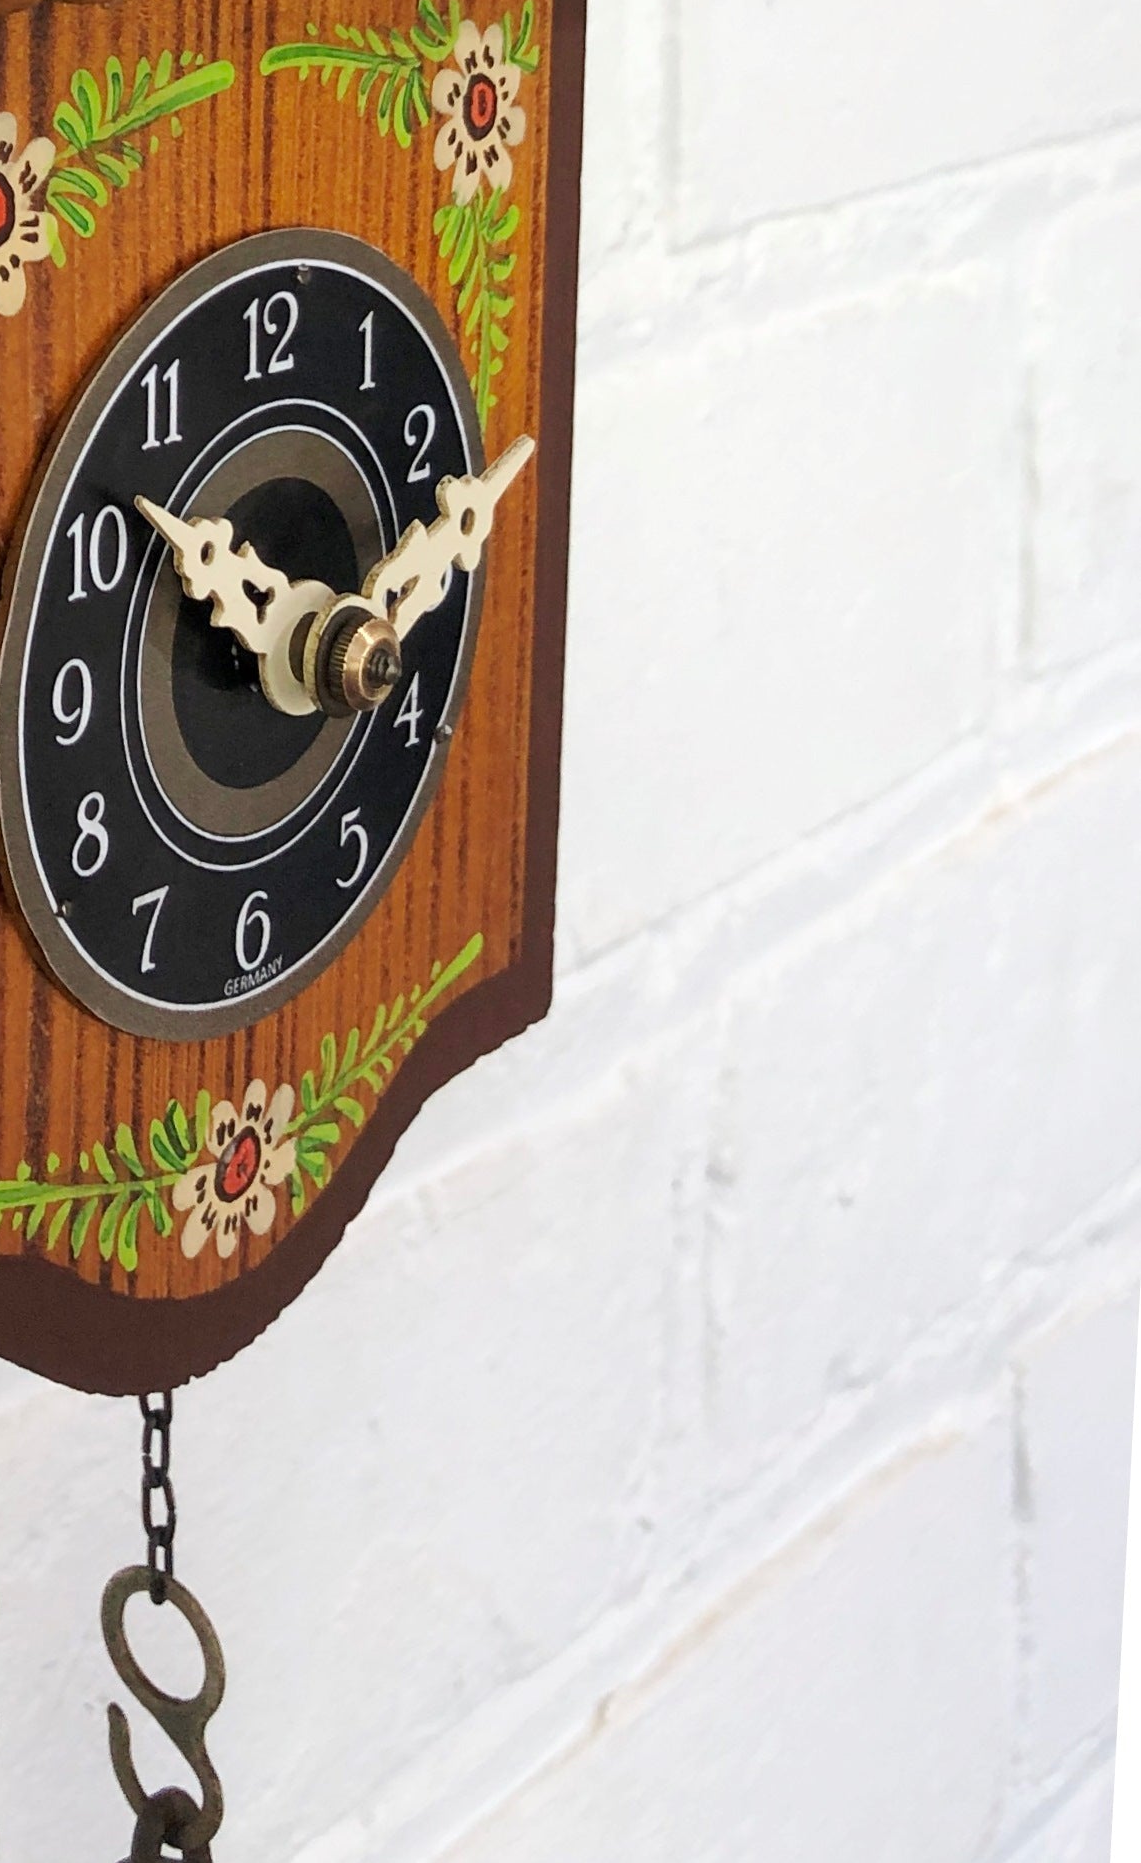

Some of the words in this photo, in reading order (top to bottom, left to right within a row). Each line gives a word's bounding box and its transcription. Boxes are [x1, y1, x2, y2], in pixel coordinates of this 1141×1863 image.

[242, 291, 299, 382] 12
[358, 310, 377, 390] 1
[139, 358, 183, 451] 11
[403, 403, 437, 484] 2
[65, 505, 129, 603] 10
[52, 658, 93, 746] 9
[393, 671, 424, 748] 4
[70, 791, 110, 878] 8
[335, 806, 369, 889] 5
[131, 885, 170, 974] 7
[234, 889, 272, 971] 6
[222, 954, 284, 997] GERMANY
